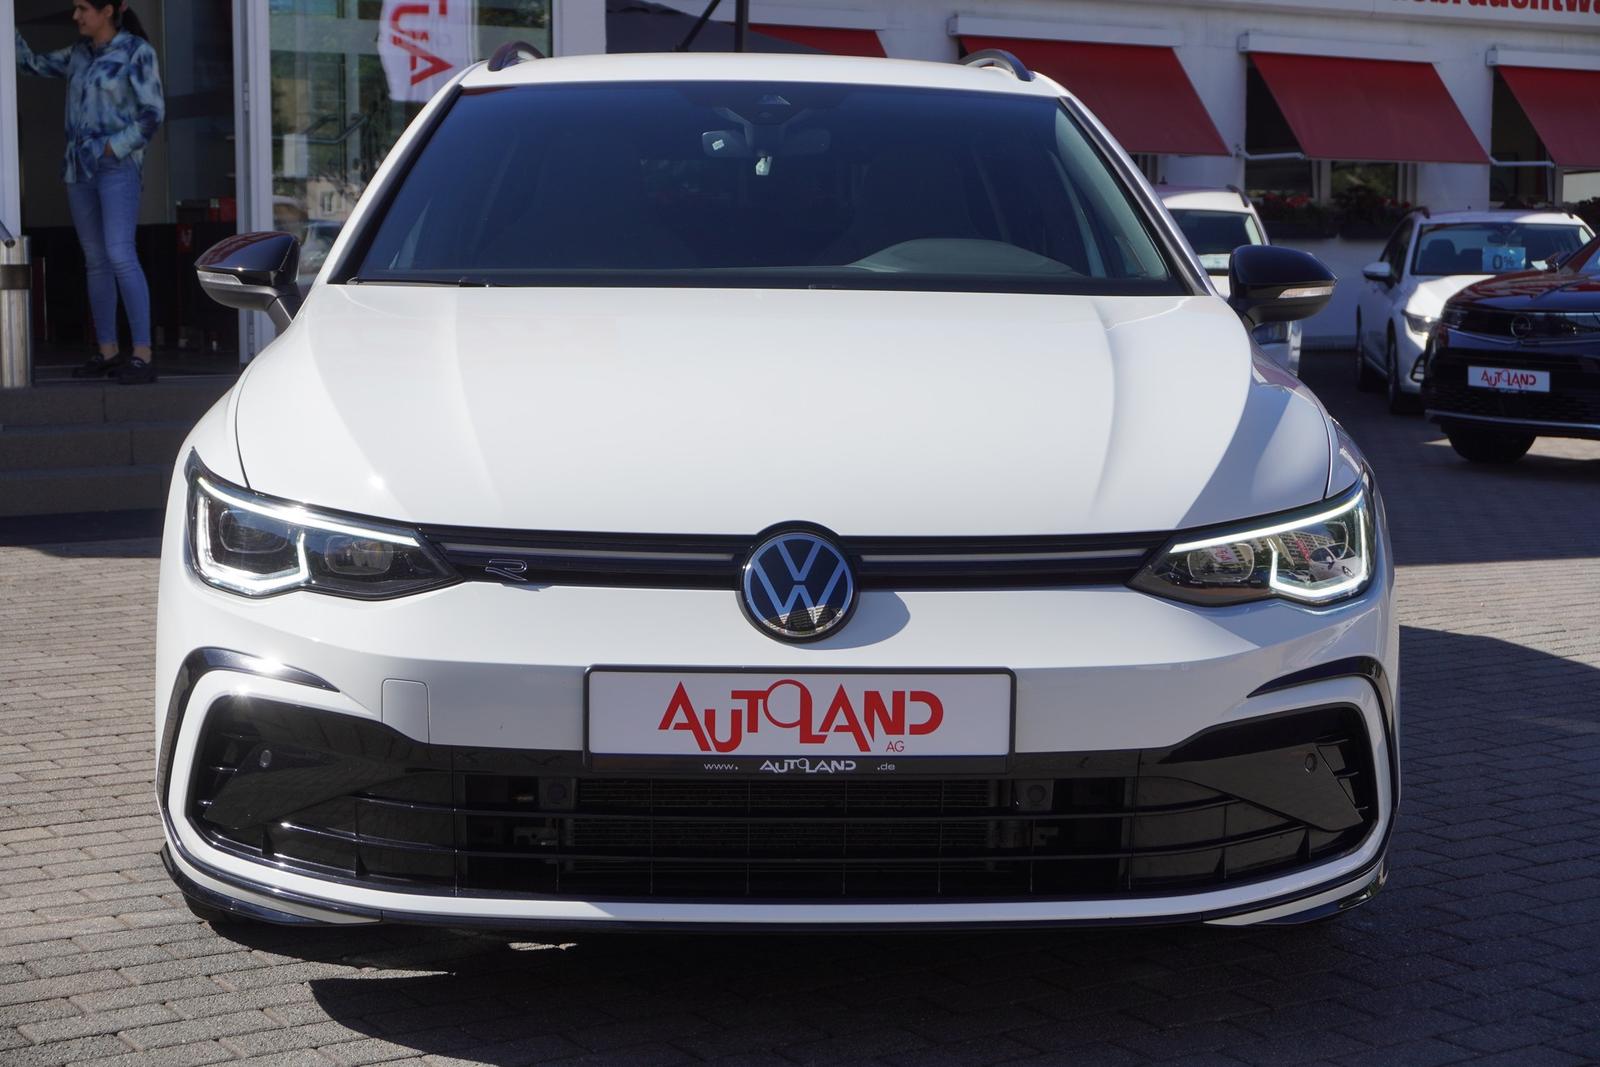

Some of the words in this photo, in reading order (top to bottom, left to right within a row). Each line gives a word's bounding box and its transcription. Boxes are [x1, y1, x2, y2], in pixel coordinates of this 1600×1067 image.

[1481, 368, 1537, 388] AUTOLAND
[658, 679, 944, 753] AUTOLAND
[885, 740, 905, 753] AG
[703, 760, 739, 771] www.
[759, 757, 857, 774] AUTOLAND
[877, 762, 896, 771] .de
